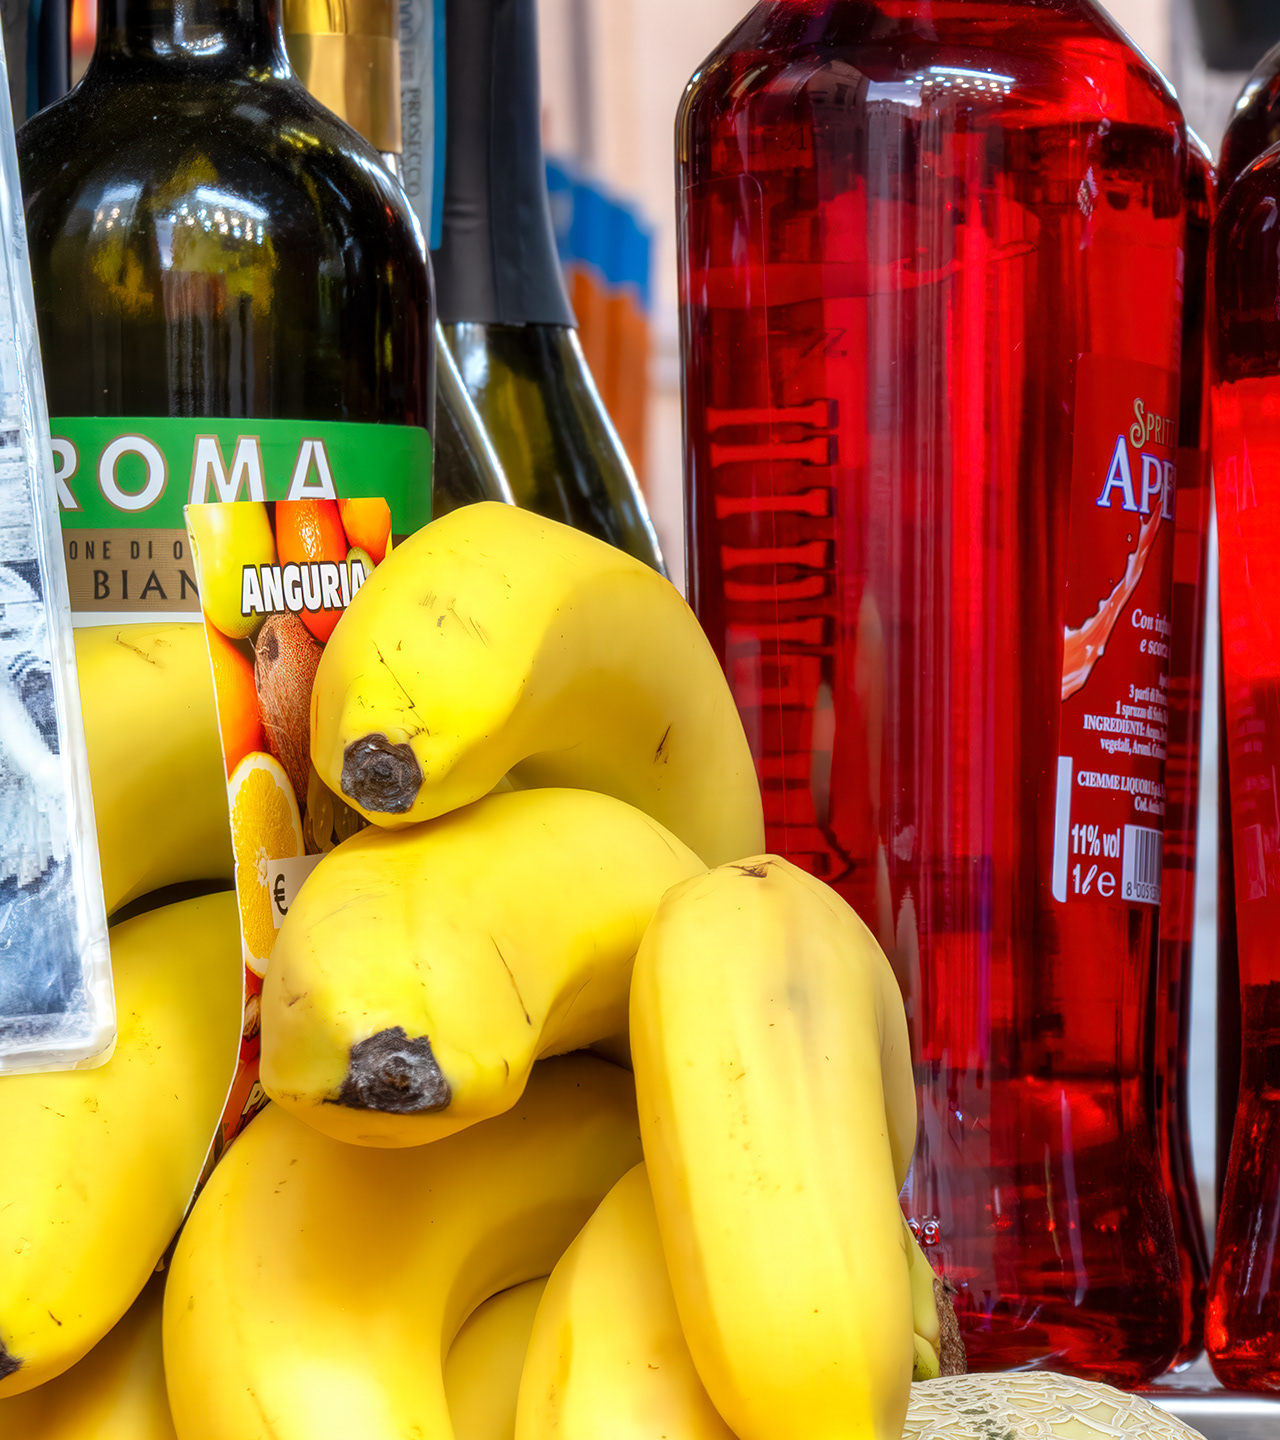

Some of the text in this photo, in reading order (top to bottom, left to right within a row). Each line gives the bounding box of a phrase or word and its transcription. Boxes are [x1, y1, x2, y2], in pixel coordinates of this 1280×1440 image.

[52, 433, 340, 512] ROMA
[241, 559, 372, 618] ANGURIA
[1077, 771, 1120, 790] CIEMME
[1072, 823, 1120, 858] 11% vol
